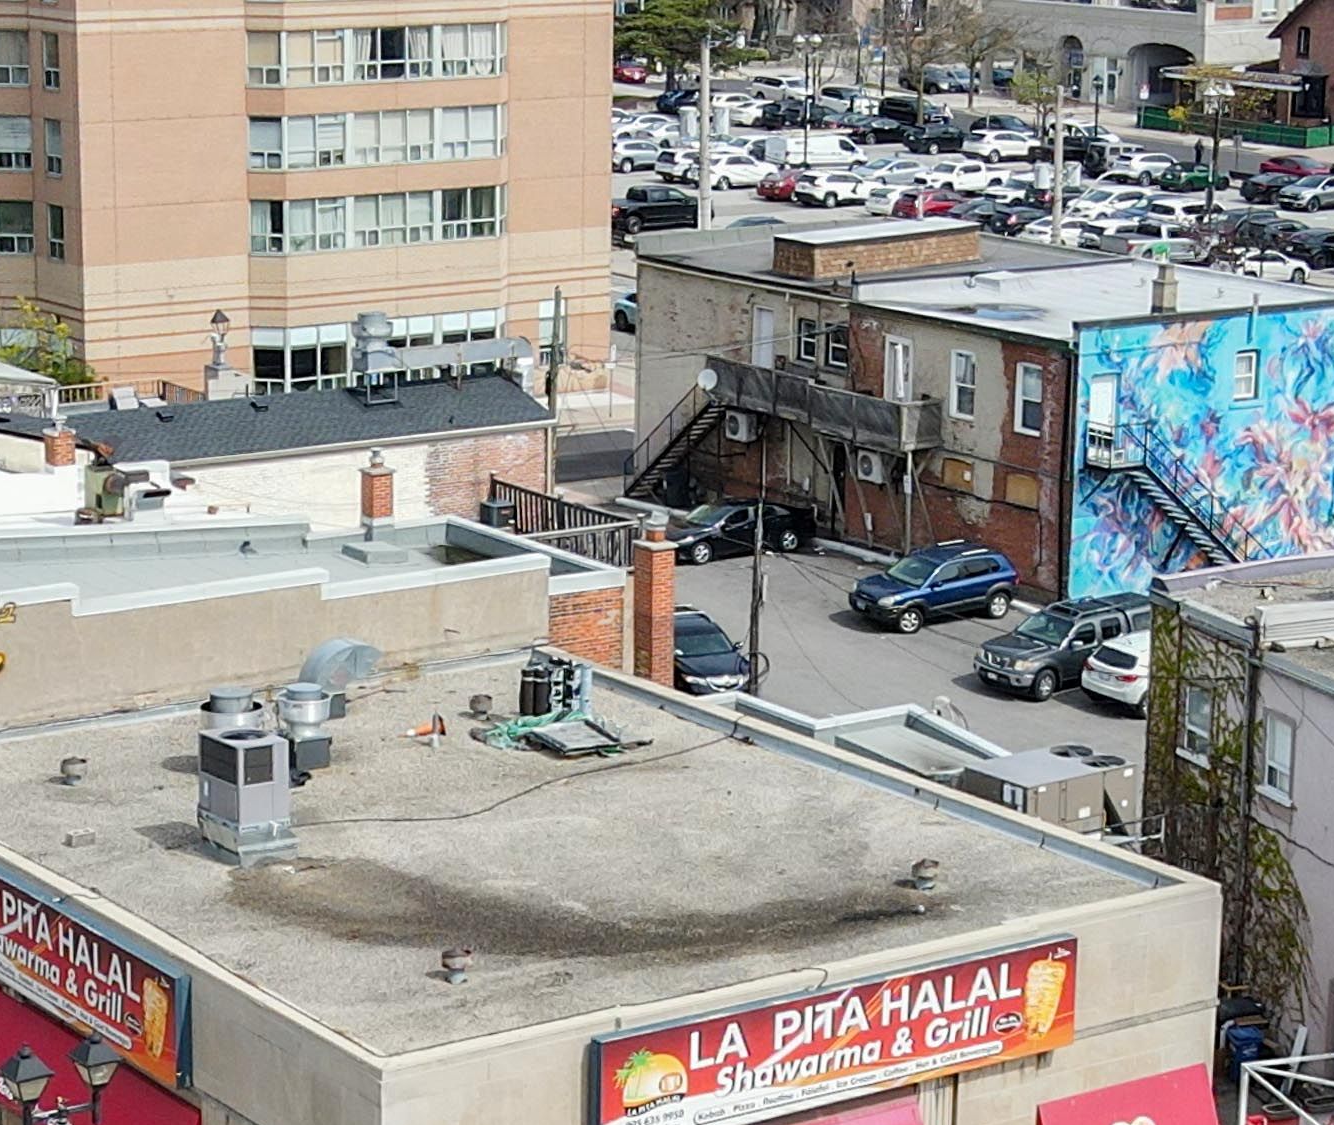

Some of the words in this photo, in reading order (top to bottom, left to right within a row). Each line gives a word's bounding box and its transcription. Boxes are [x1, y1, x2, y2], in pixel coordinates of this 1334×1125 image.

[1, 888, 53, 952] PITA
[58, 921, 141, 1004] HALAL
[65, 967, 79, 998] &
[83, 978, 123, 1023] Grill
[689, 1021, 751, 1071] LA
[773, 996, 870, 1051] PITA
[880, 963, 1023, 1027] HALAL
[716, 1039, 883, 1098] Shawarma
[890, 1026, 914, 1057] &
[924, 1006, 992, 1049] Grill
